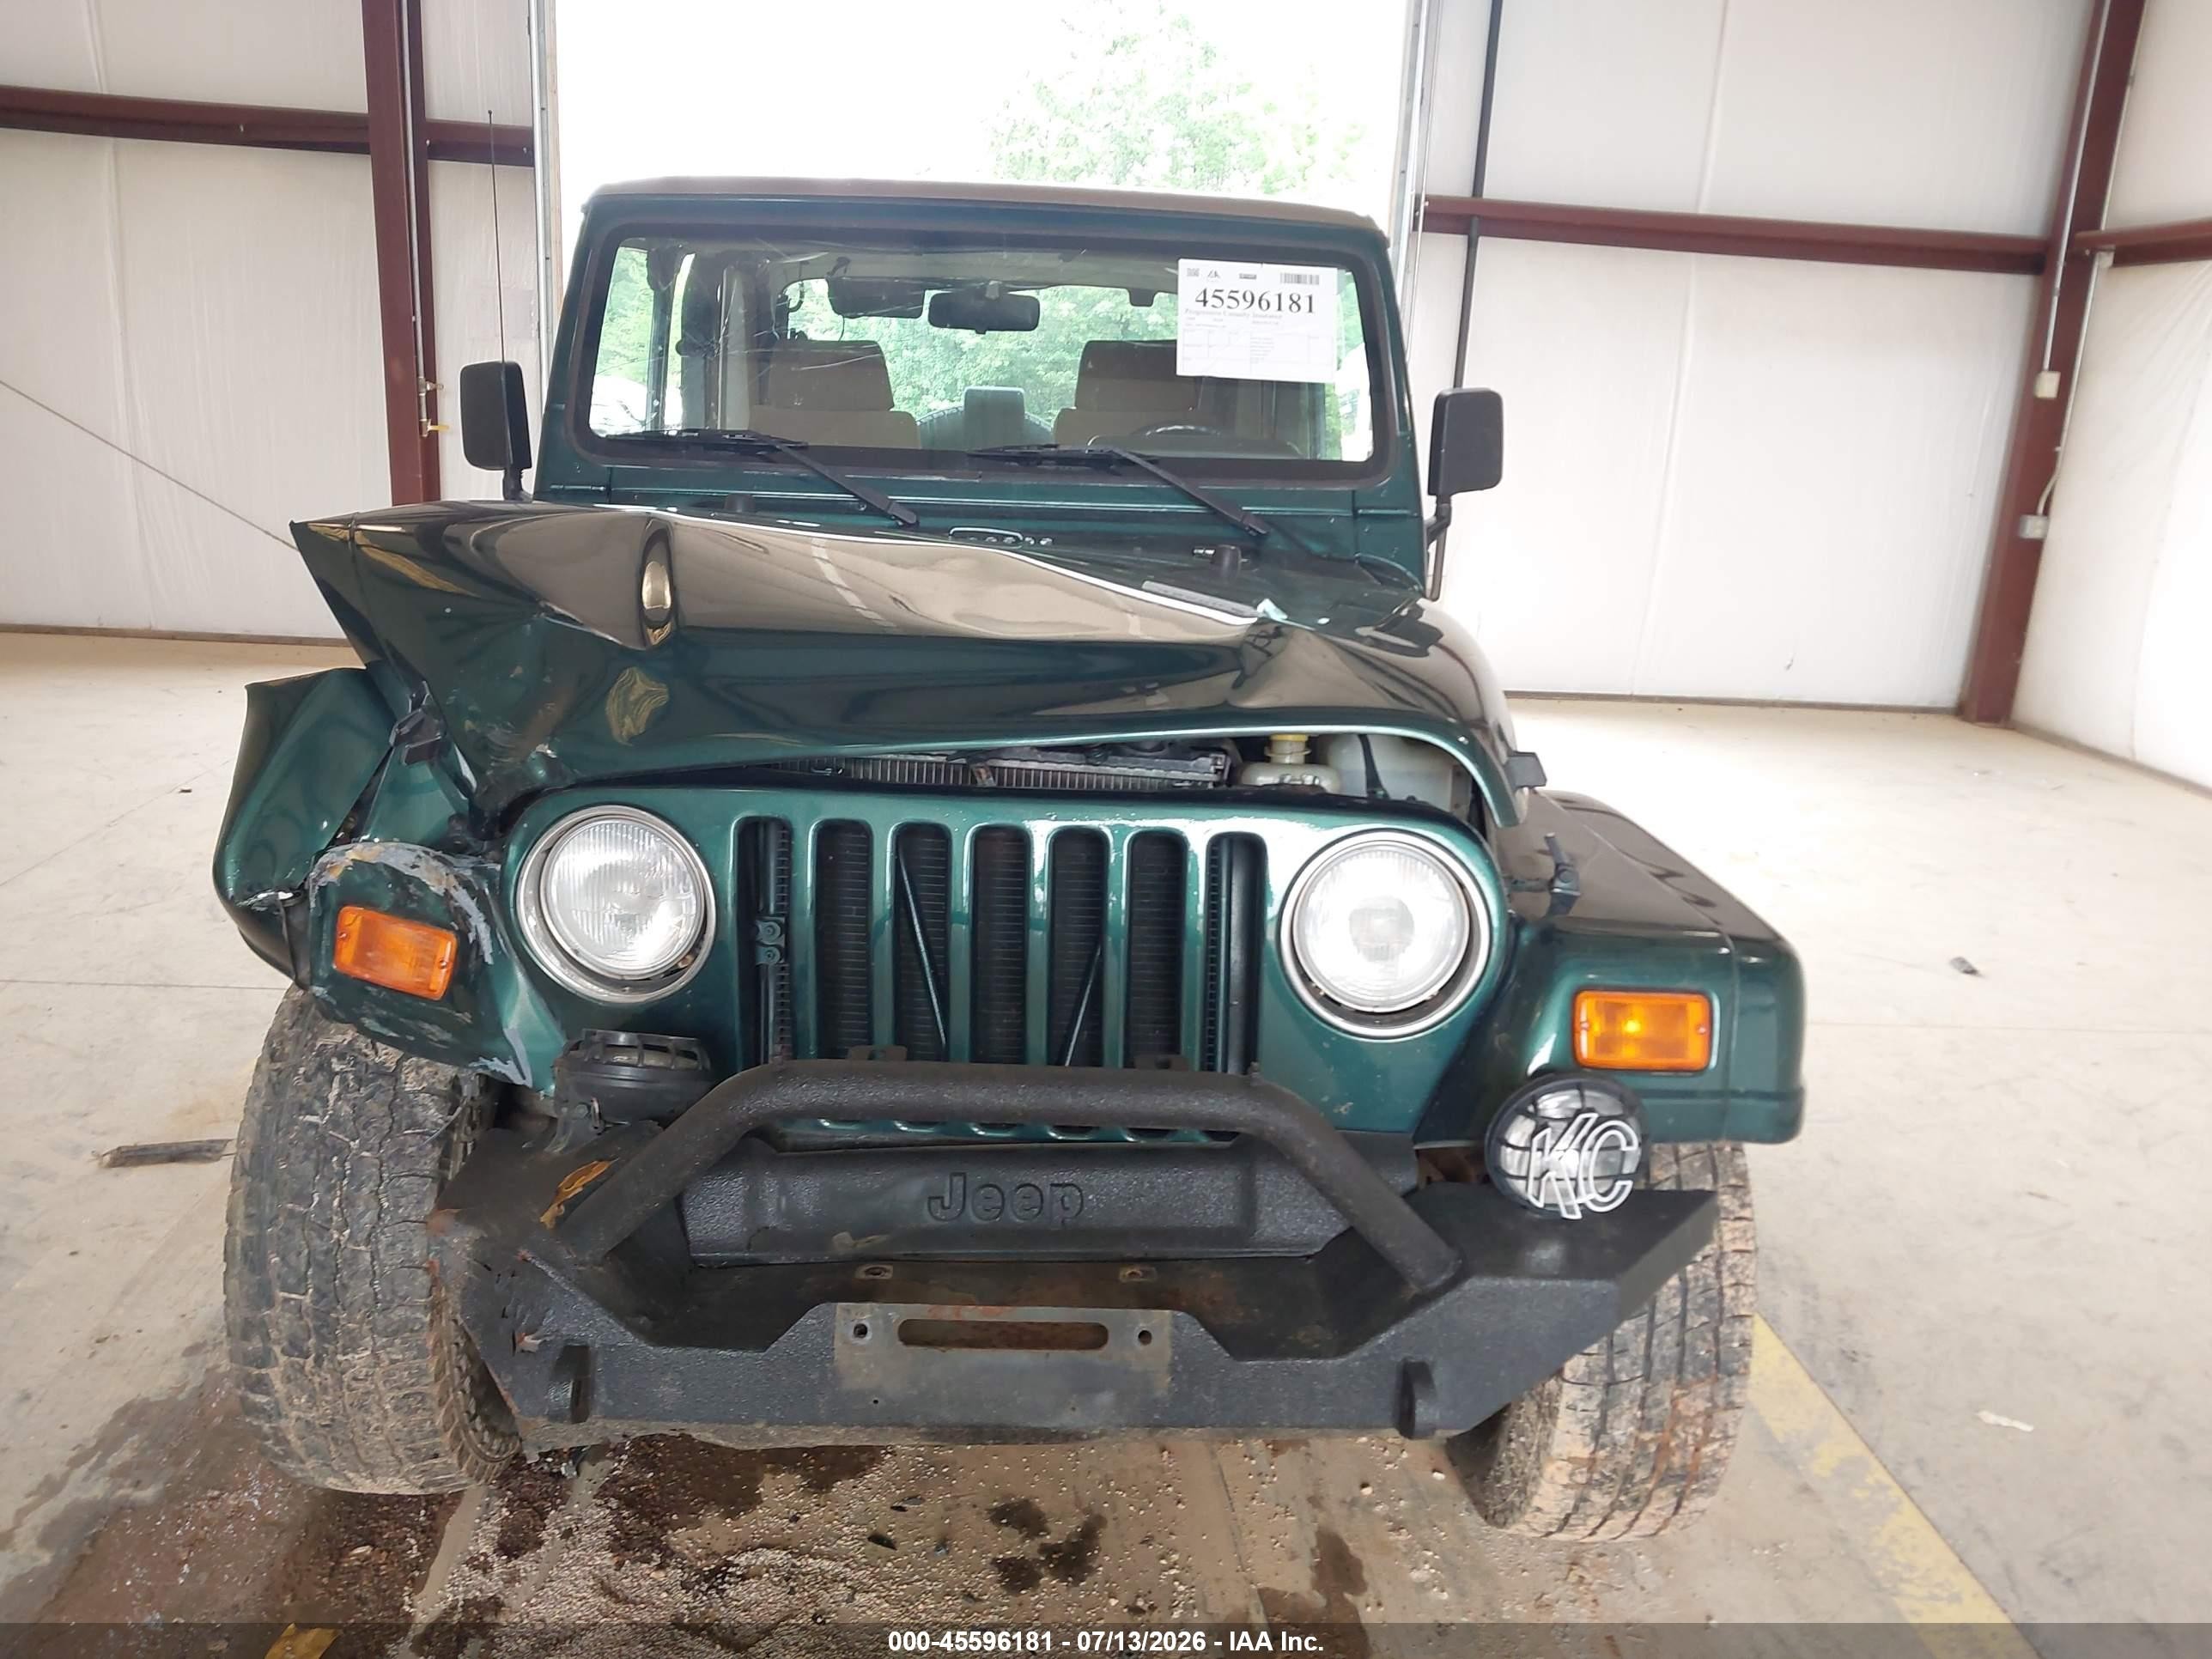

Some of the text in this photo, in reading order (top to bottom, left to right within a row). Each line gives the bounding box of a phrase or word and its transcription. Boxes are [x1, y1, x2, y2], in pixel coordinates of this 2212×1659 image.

[1195, 288, 1314, 313] 45596181
[1527, 1112, 1639, 1220] KC
[927, 1172, 1085, 1224] Jeep
